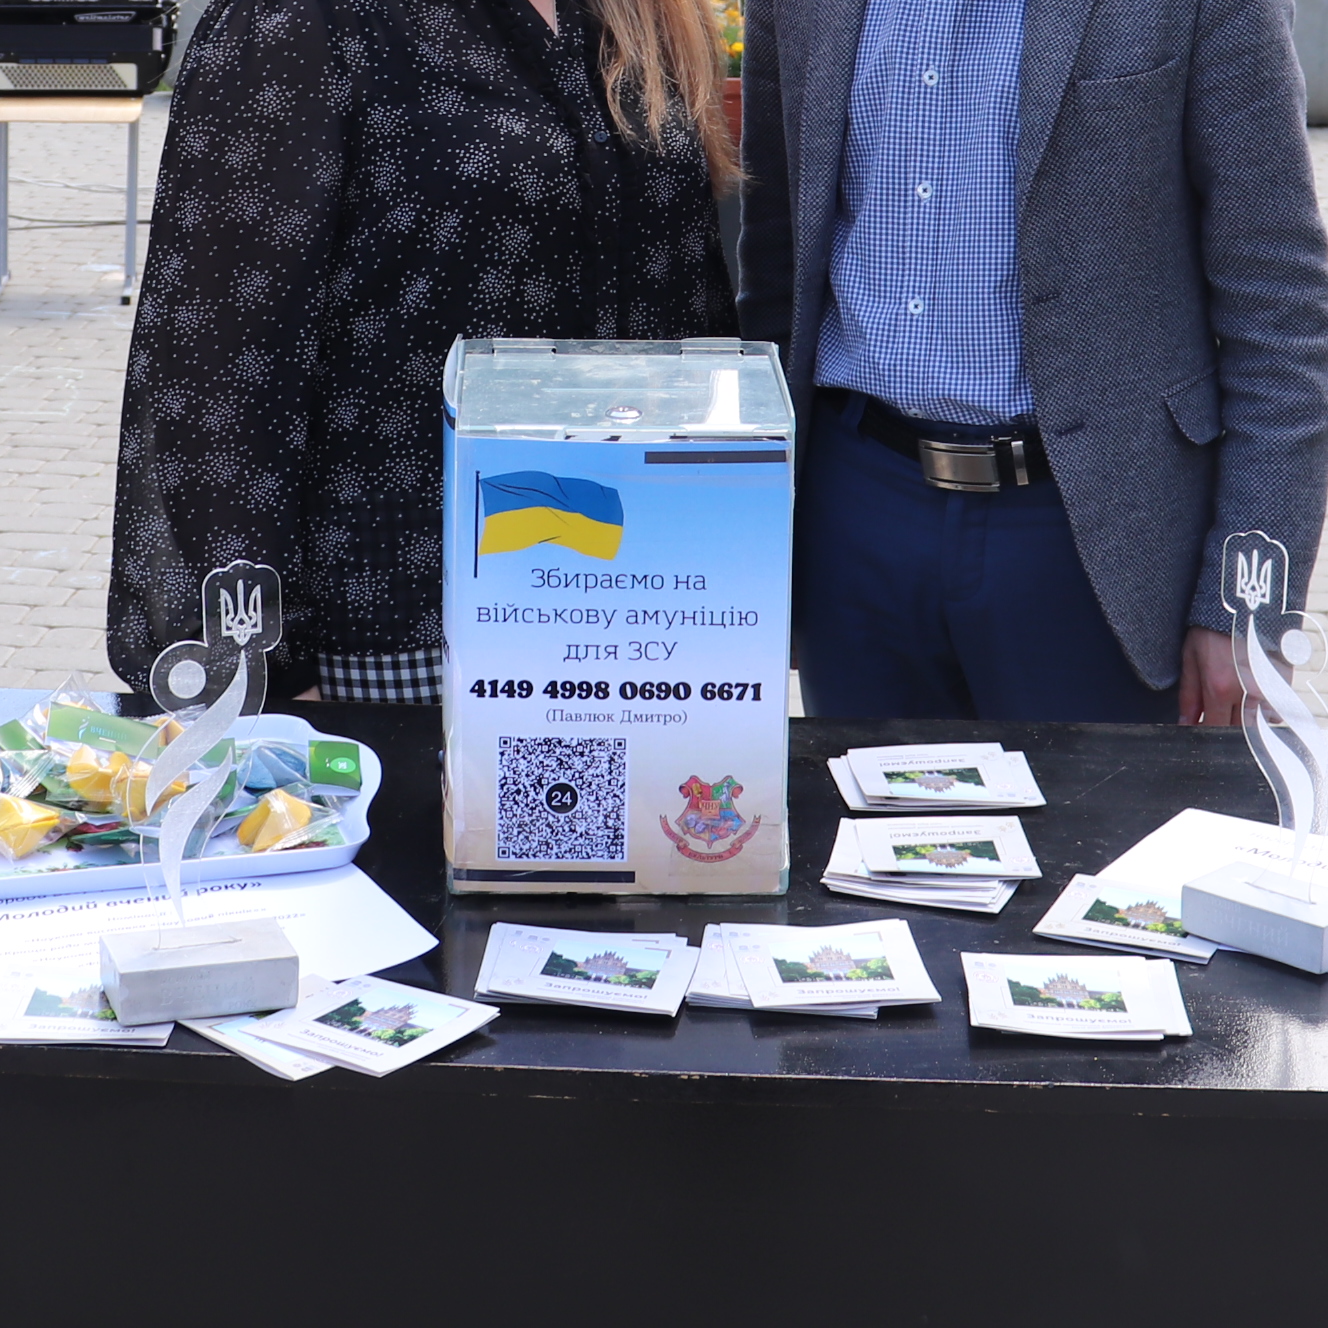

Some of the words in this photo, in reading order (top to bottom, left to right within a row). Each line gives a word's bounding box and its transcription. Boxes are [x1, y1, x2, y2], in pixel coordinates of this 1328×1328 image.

[530, 568, 665, 594] Збираємо
[673, 574, 707, 592] на
[475, 601, 617, 629] військову
[625, 605, 760, 629] амуніцію
[562, 643, 618, 664] для
[627, 641, 678, 662] ЗСУ
[469, 678, 534, 700] 4149
[542, 679, 610, 700] 4998
[619, 680, 692, 701] 0690
[700, 681, 763, 702] 6671
[545, 708, 615, 724] (Павлюк
[619, 709, 688, 725] Дмитро)
[550, 791, 573, 808] 24
[889, 829, 981, 840] Запрошуємо!
[196, 880, 263, 897] року»
[1084, 926, 1182, 947] Запрошуємо!
[543, 982, 648, 1000] Запрошуємо!
[797, 985, 900, 996] Запрошуємо!
[1026, 1013, 1133, 1025] Запрошуємо!
[27, 1023, 136, 1035] Запрошуємо!
[299, 1028, 384, 1059] Запрошуємо!
